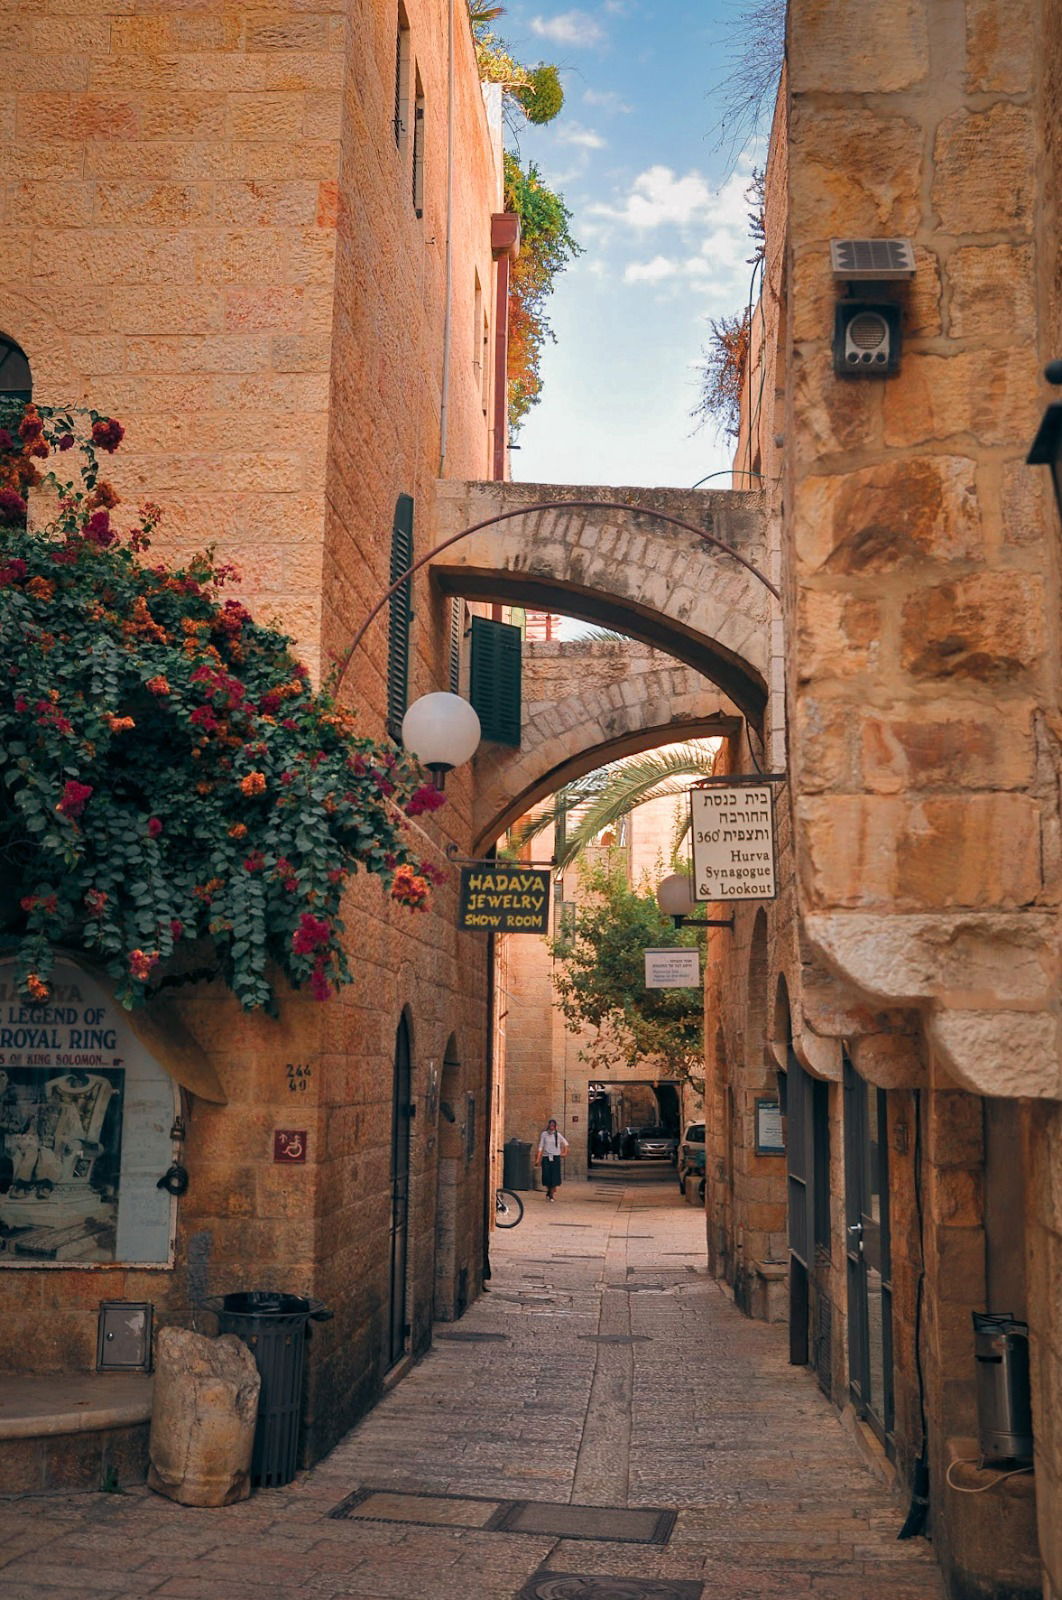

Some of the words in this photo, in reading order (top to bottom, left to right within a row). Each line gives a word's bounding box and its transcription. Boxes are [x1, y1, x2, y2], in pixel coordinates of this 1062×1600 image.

[703, 794, 737, 807] כנסת
[745, 793, 768, 805] בית
[719, 811, 769, 824] החורבה
[723, 829, 769, 842] ותצפית
[731, 850, 770, 862] Hurva
[705, 866, 771, 880] Synagogue
[468, 873, 545, 893] HADAYA
[699, 883, 712, 896] &
[720, 882, 772, 895] Lookout
[467, 894, 545, 911] JEWELRY
[464, 914, 502, 927] SHOW
[506, 914, 543, 928] ROOM
[8, 1007, 78, 1025] LEGEND
[83, 1007, 106, 1025] OF
[0, 1028, 62, 1049] ROYAL
[69, 1028, 117, 1050] RING
[26, 1053, 51, 1065] KING
